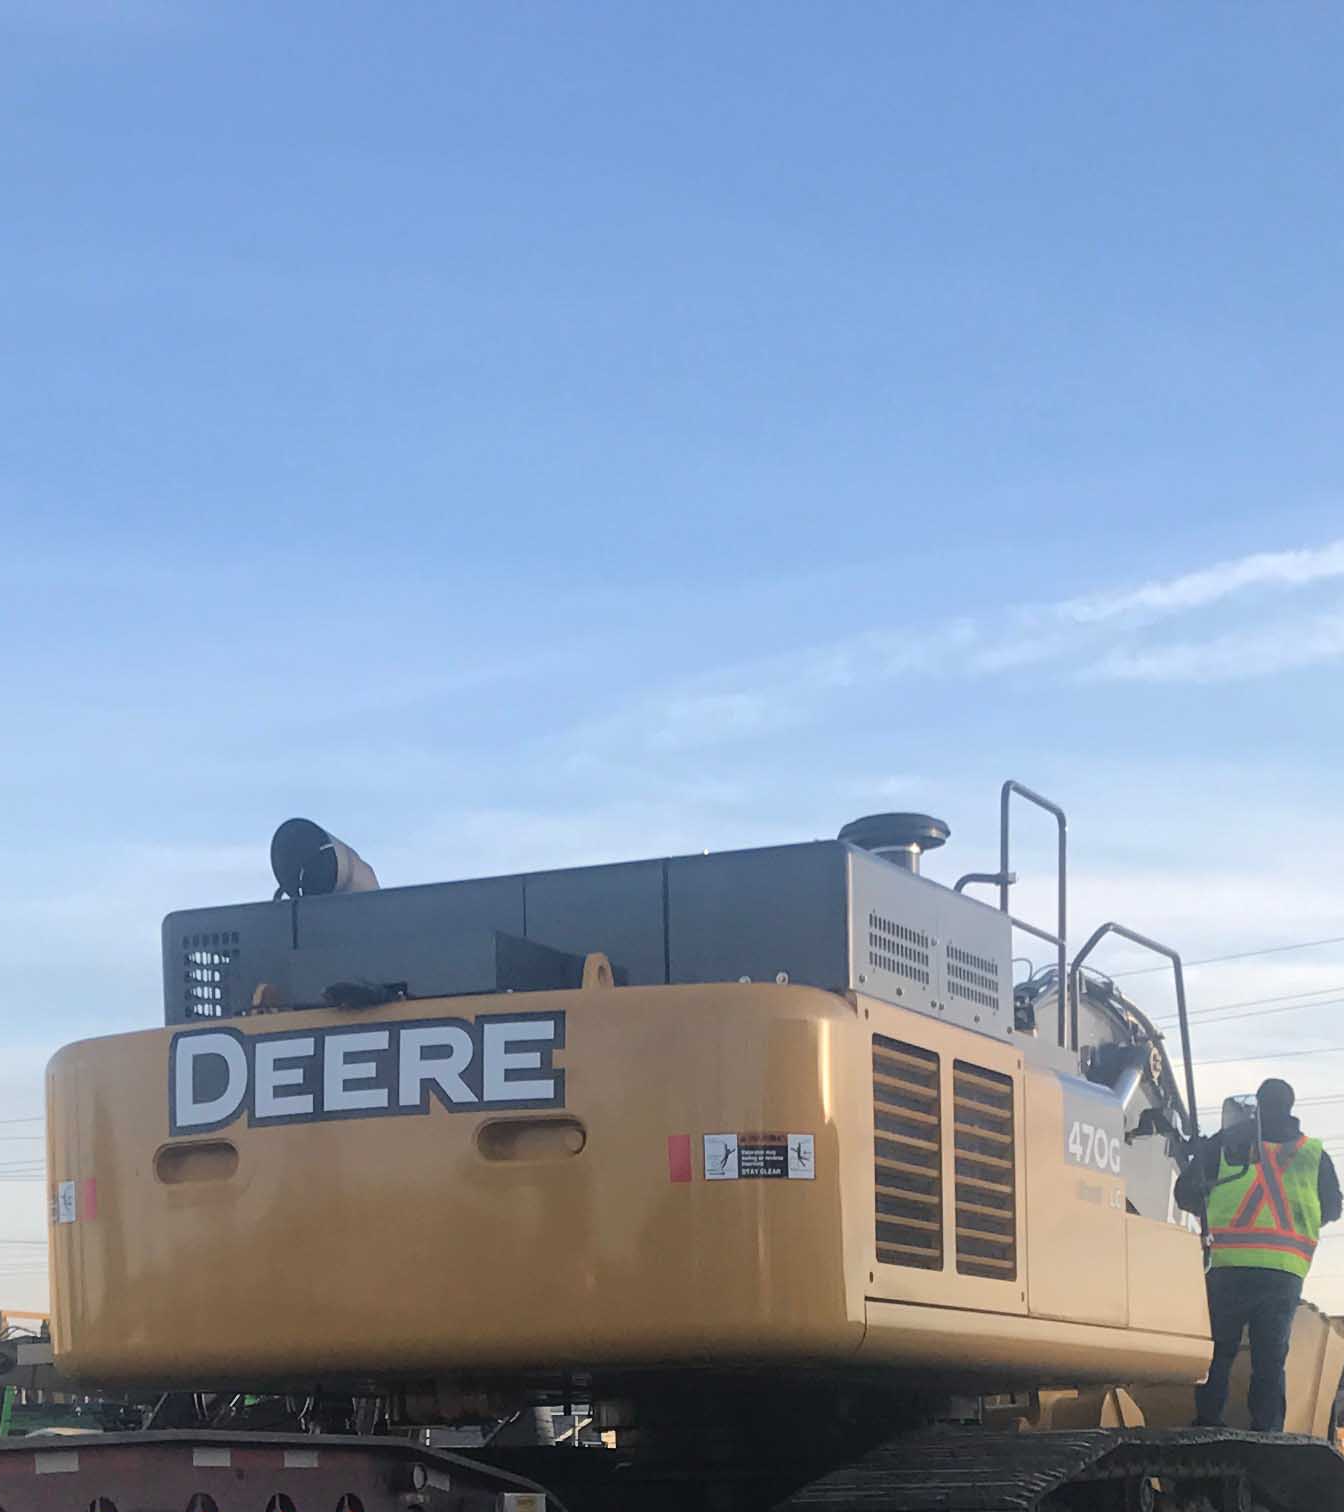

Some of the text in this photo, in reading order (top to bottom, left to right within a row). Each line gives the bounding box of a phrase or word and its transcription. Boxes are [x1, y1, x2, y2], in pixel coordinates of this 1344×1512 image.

[173, 1018, 557, 1128] DEERE
[741, 1167, 782, 1175] STAY CLEAR
[1068, 1120, 1121, 1174] 470G
